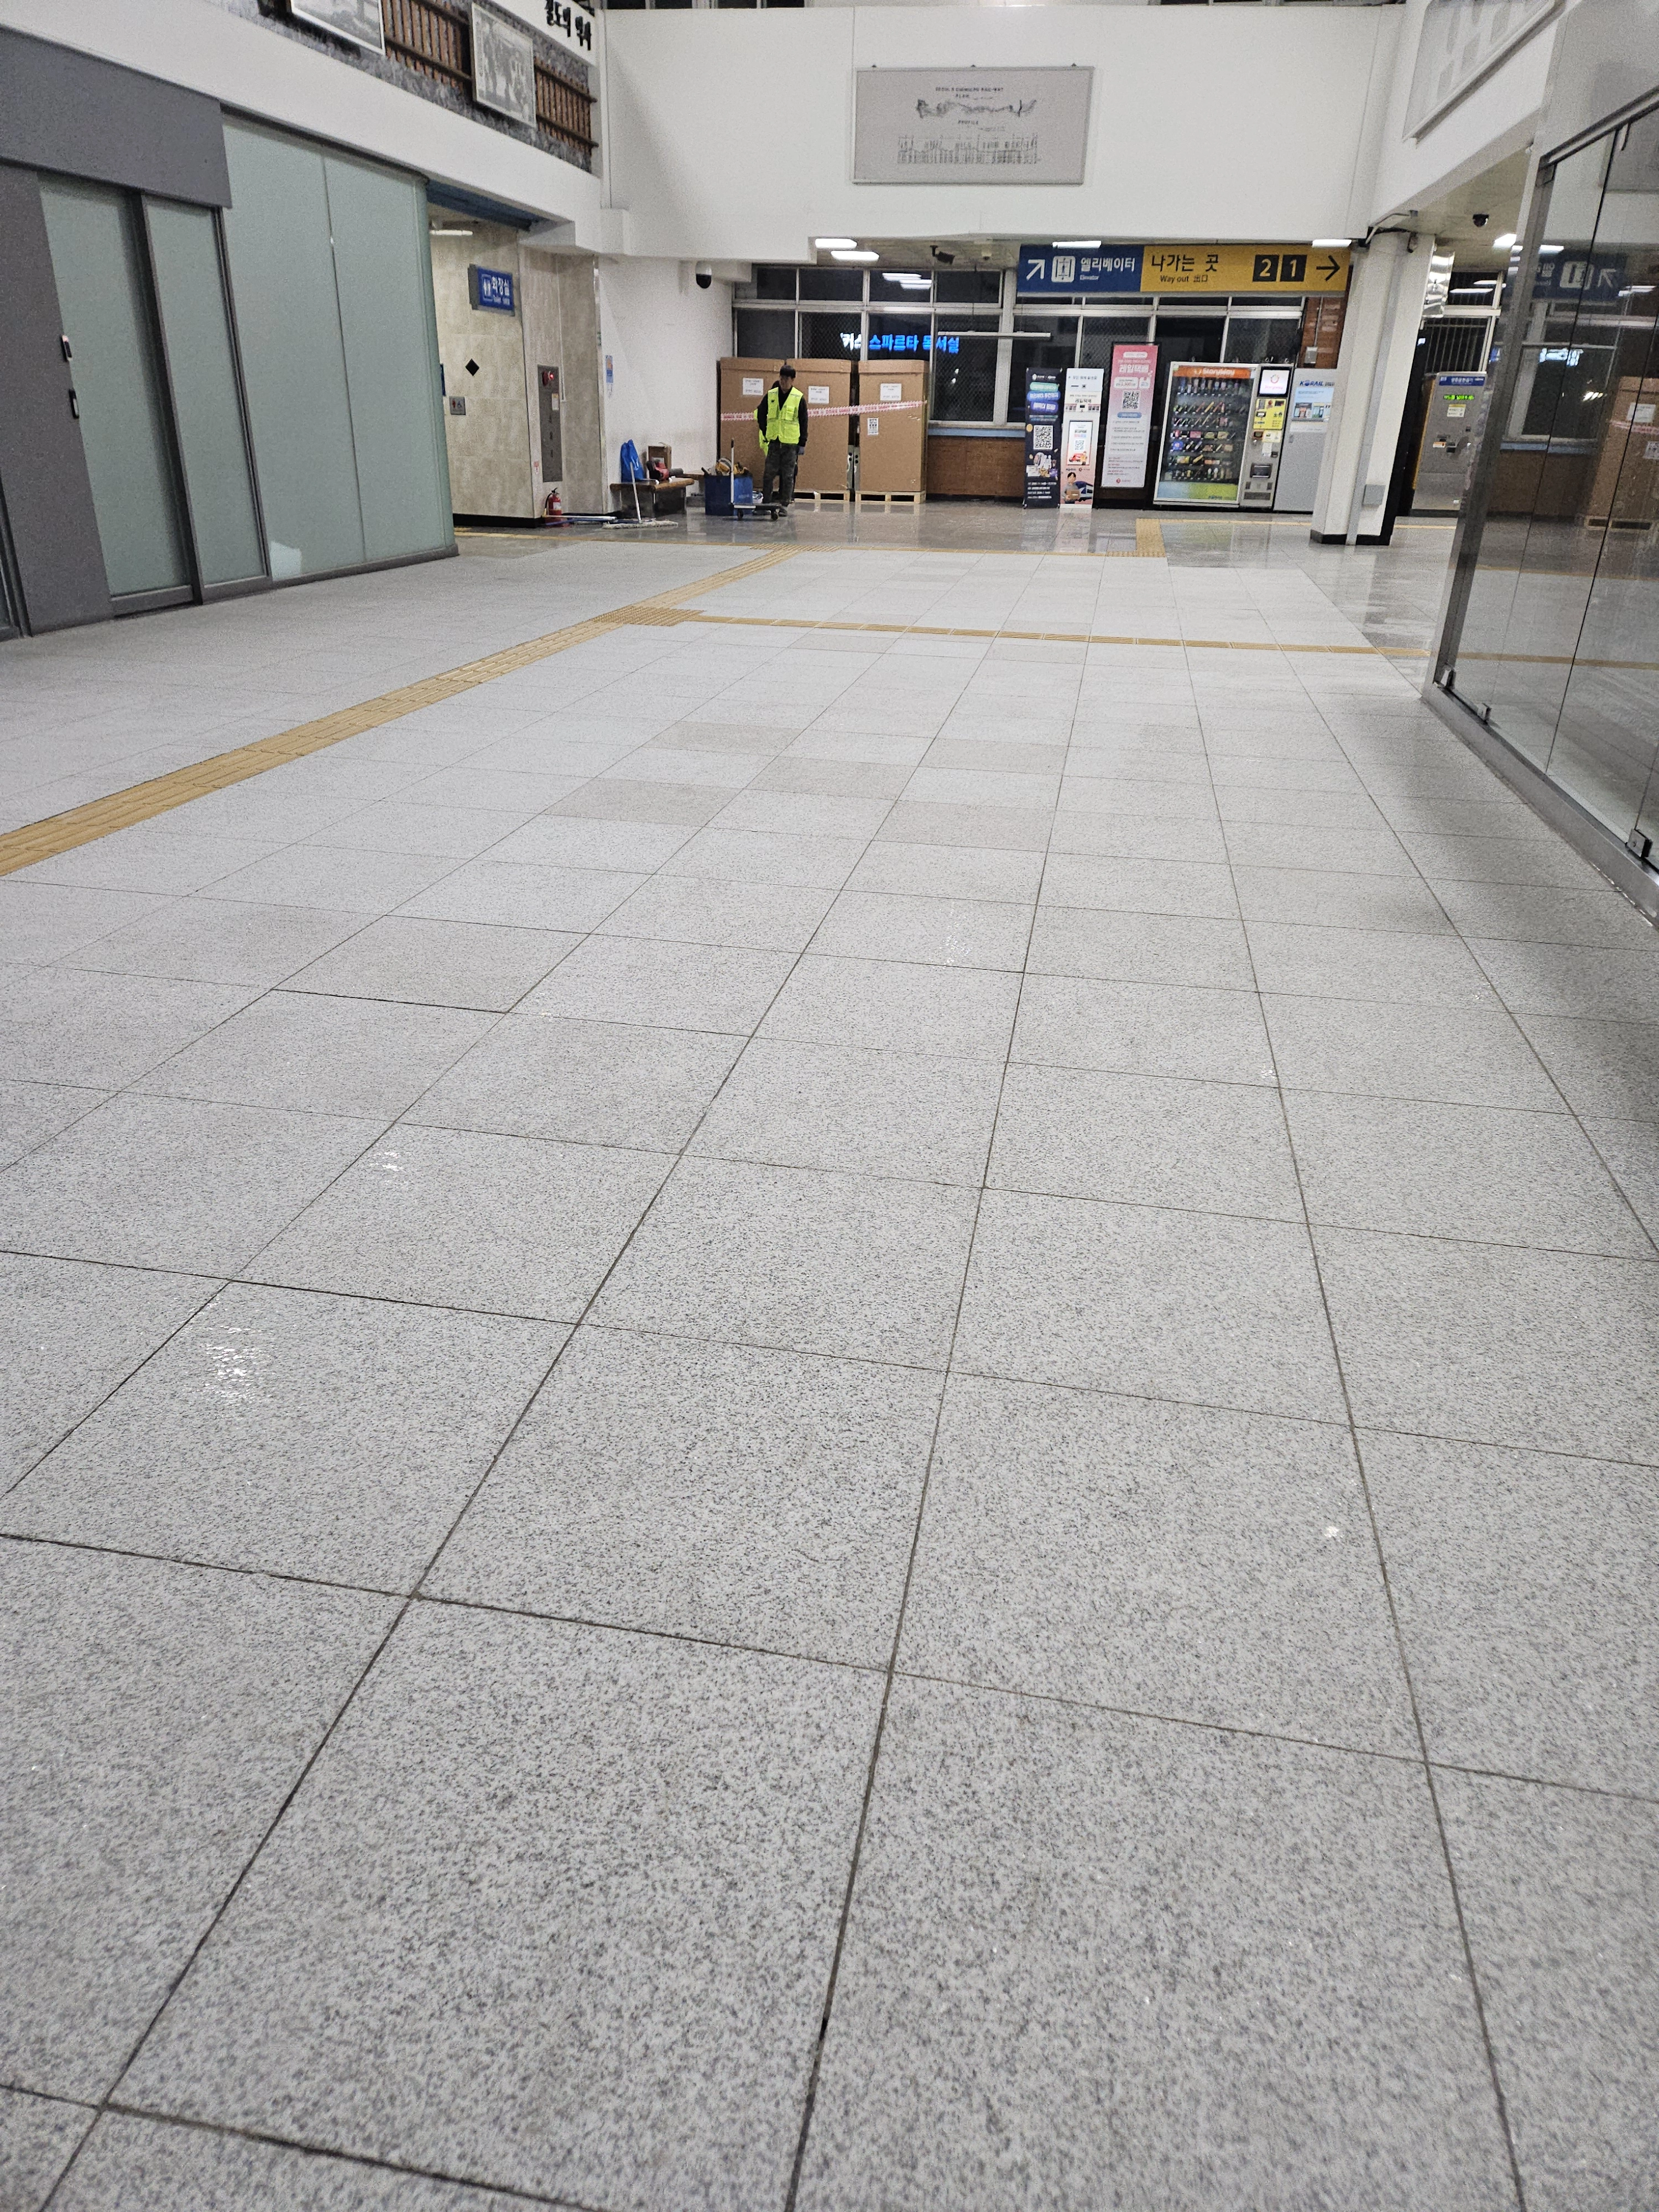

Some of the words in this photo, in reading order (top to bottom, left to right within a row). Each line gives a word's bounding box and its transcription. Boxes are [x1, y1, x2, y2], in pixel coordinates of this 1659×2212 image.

[575, 15, 591, 51] 역사
[1081, 257, 1135, 273] 엘리베이터
[1151, 254, 1195, 272] 나가는
[1206, 254, 1219, 272] 곳
[1260, 258, 1271, 276] 2
[1290, 259, 1297, 277] 1
[492, 276, 510, 296] 화장실
[1160, 275, 1175, 284] Way
[1193, 274, 1208, 283] 出口
[869, 334, 919, 352] 스파르타
[922, 335, 959, 354] 독서실
